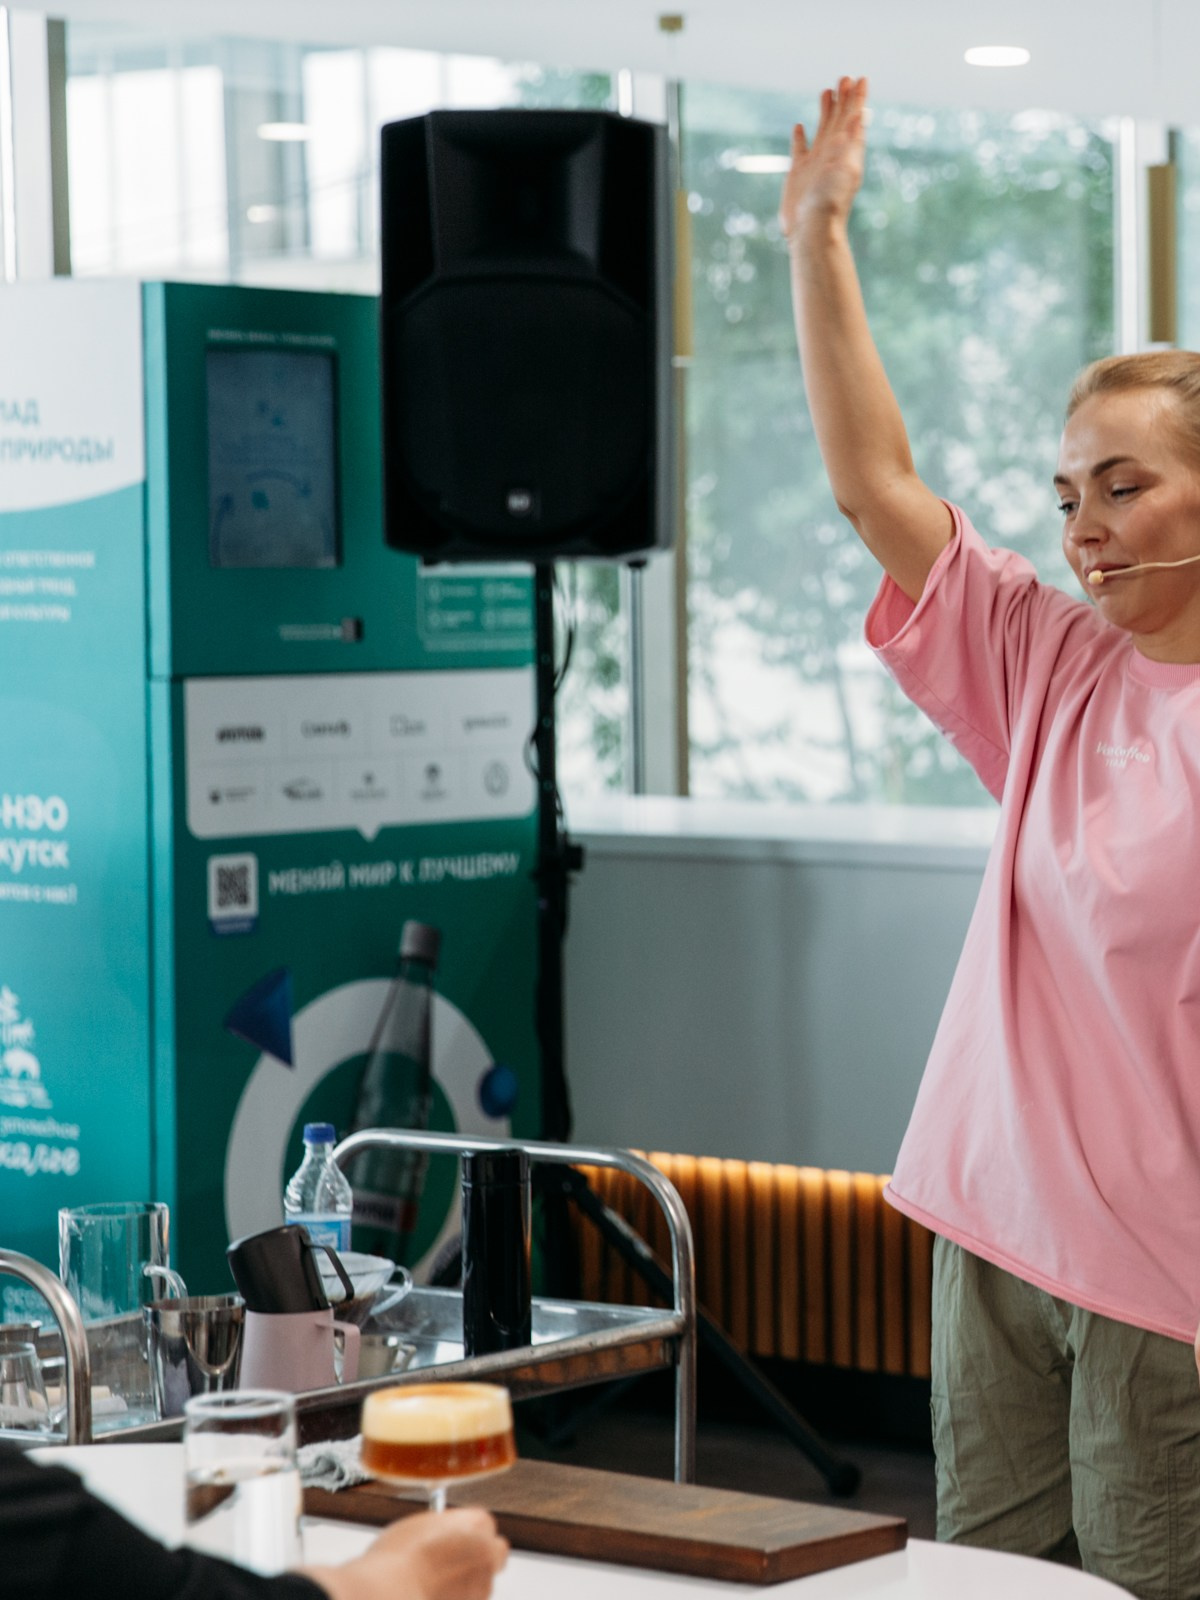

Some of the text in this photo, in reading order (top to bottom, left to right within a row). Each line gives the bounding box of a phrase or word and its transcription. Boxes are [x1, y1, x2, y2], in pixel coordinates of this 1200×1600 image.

[1, 437, 114, 464] ПРИРОДЫ
[269, 852, 520, 895] МЕНЯЙ МИР К ЛУЧШЕМУ
